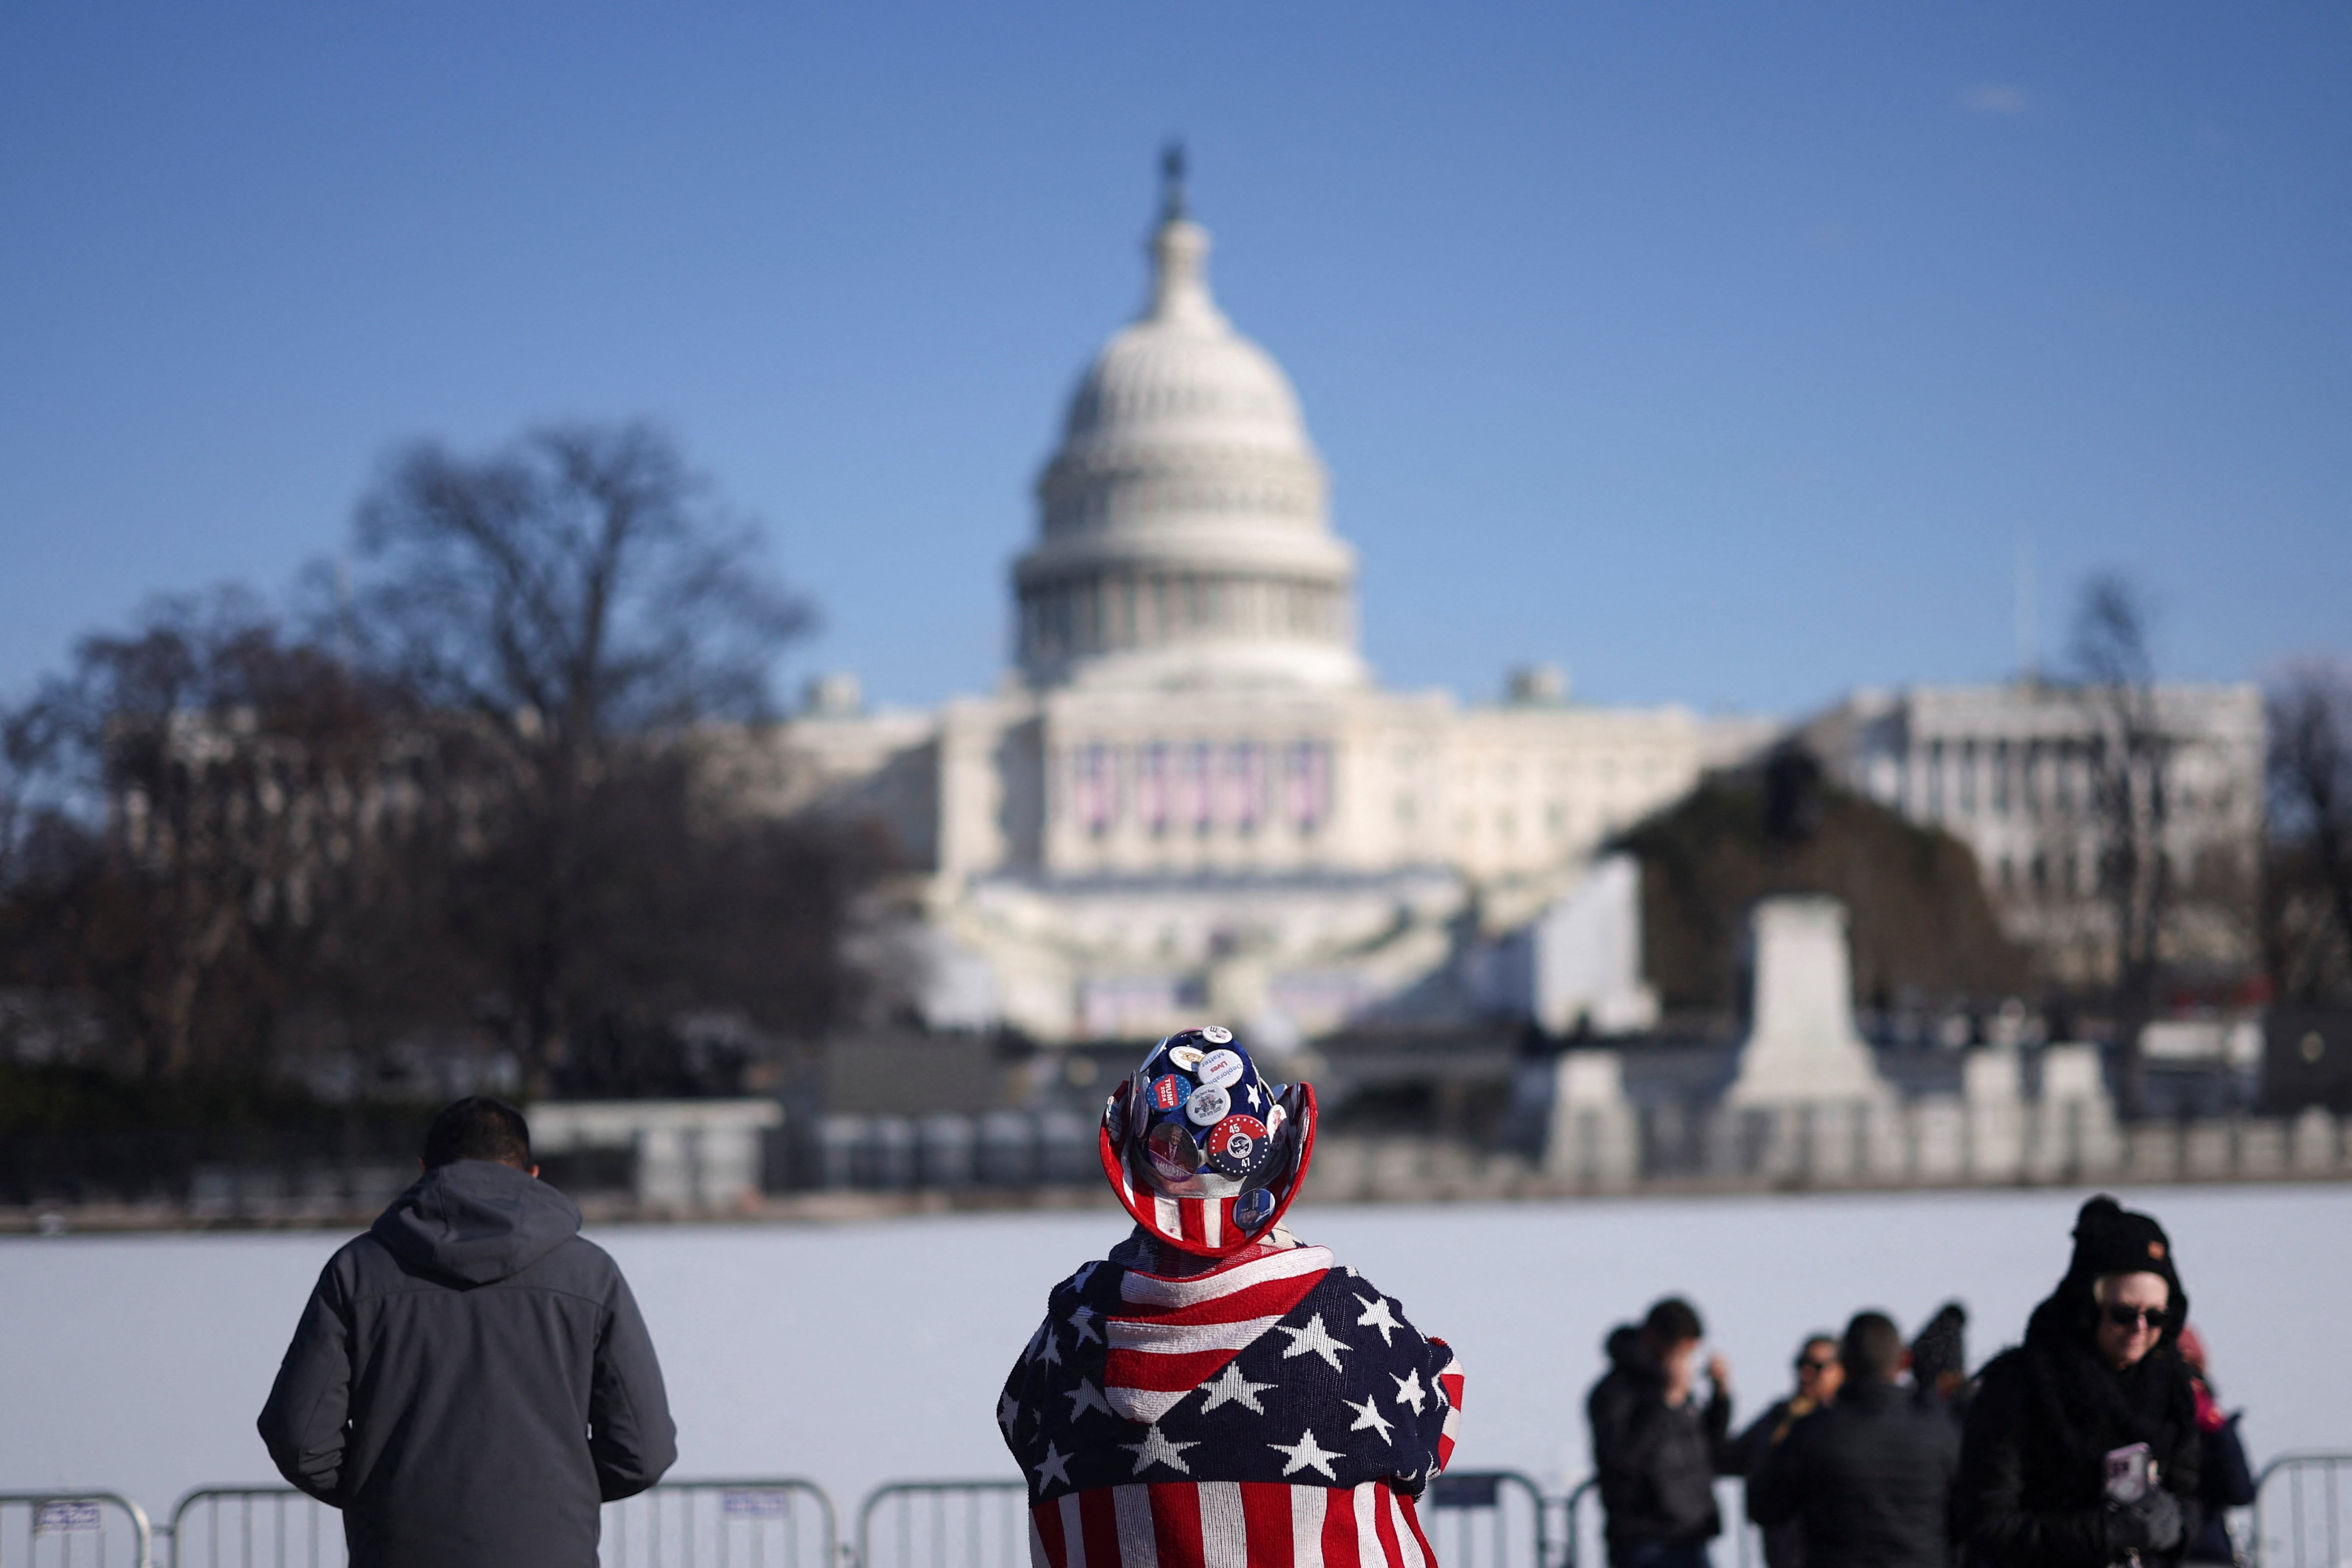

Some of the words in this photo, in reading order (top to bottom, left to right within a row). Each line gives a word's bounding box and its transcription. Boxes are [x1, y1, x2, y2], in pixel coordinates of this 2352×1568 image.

[1202, 1051, 1225, 1068] Matter
[1210, 1061, 1228, 1073] Lives
[1165, 1078, 1174, 1106] TRUMP
[1229, 1123, 1240, 1134] 45
[1155, 1158, 1185, 1177] TRUMP
[1241, 1157, 1250, 1168] 47
